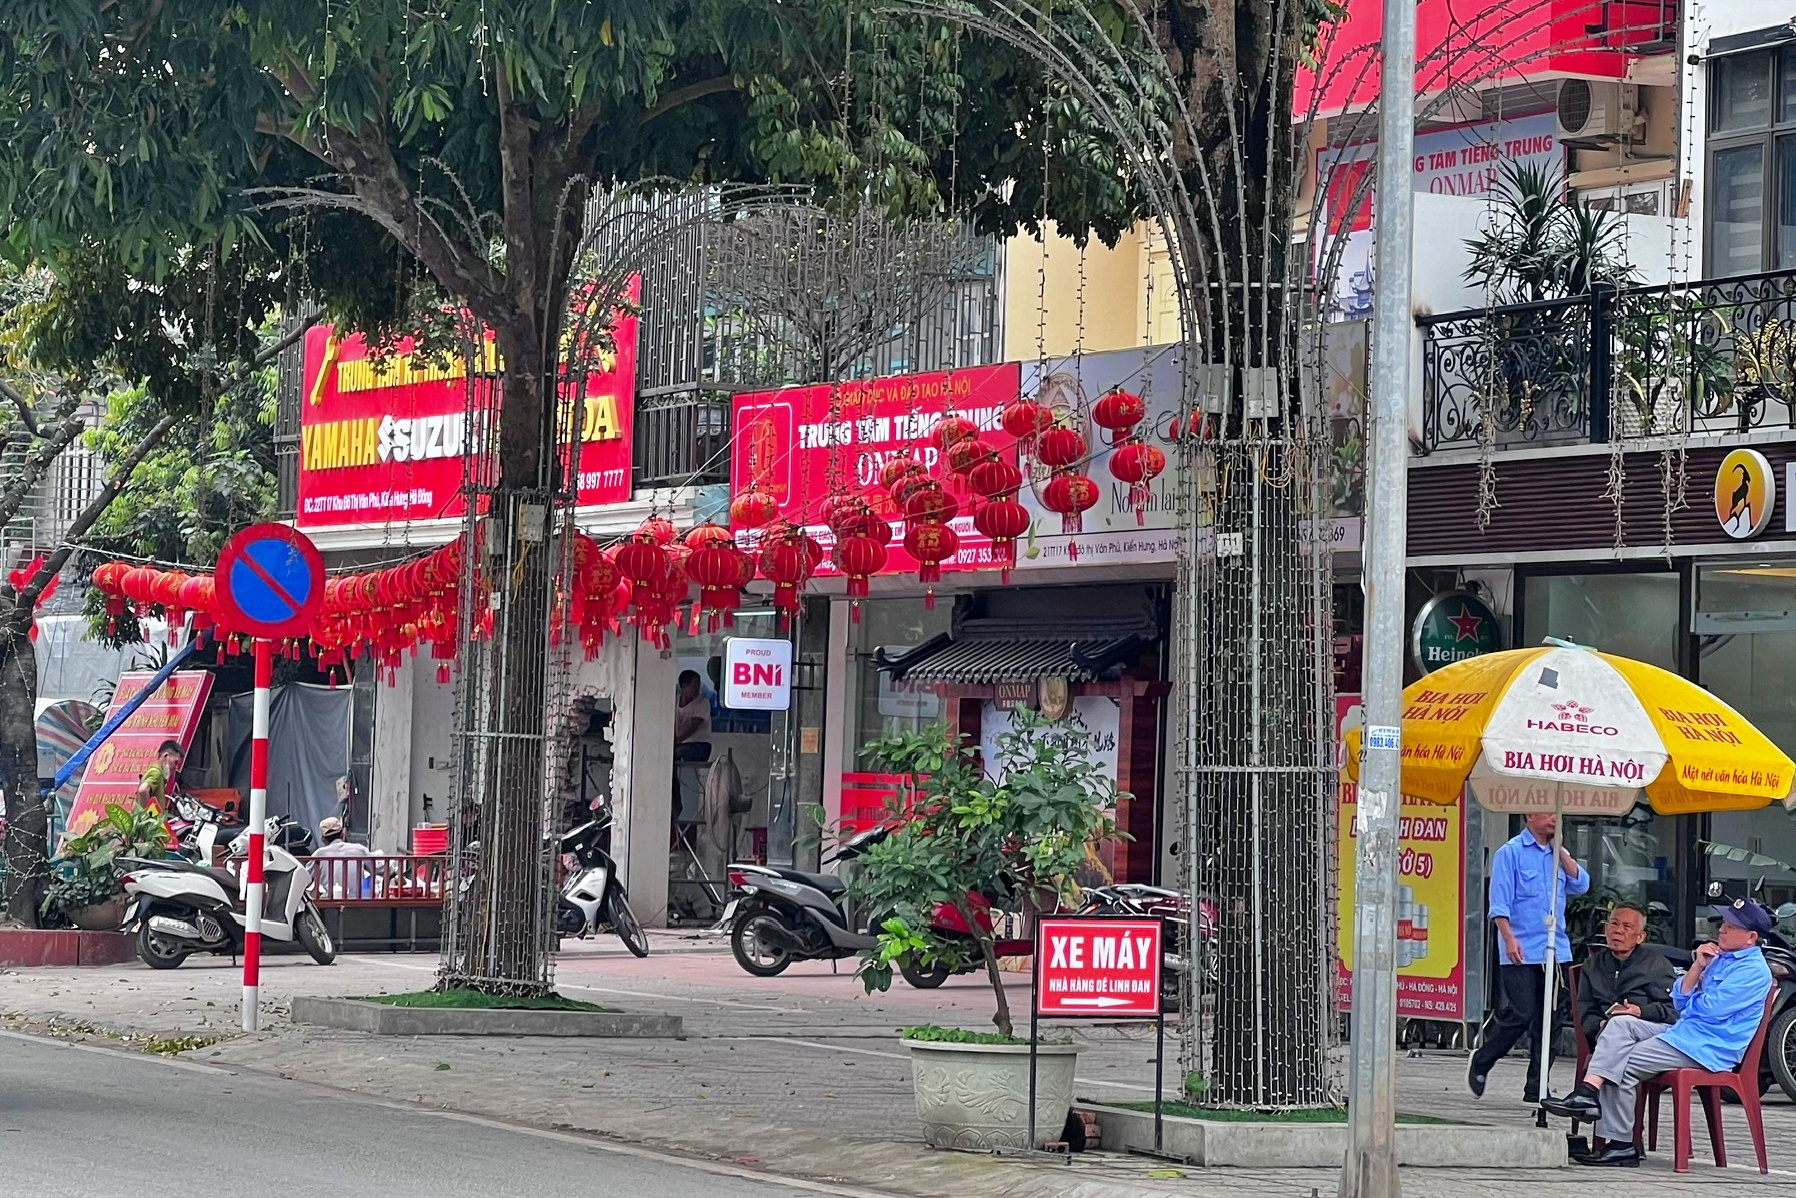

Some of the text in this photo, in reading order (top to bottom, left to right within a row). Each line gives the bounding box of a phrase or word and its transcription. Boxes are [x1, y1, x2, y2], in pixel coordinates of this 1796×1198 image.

[1428, 149, 1456, 170] TÂM
[1505, 134, 1552, 158] TRUNG
[887, 382, 898, 402] VÀ
[922, 382, 938, 402] TẠO
[955, 376, 971, 398] NỘI
[301, 416, 378, 471] YAMAHA
[604, 469, 624, 488] 7777
[957, 548, 976, 564] 0927
[746, 648, 772, 657] PROUD
[741, 692, 772, 700] MEMBER
[998, 684, 1032, 699] ONMAP
[1414, 690, 1450, 703] BIA
[1402, 704, 1470, 724] HÀ NỘI
[1658, 706, 1693, 724] BIA
[1527, 720, 1618, 736] HABECO
[1704, 728, 1744, 748] NỘI
[1414, 744, 1430, 758] hóa
[1432, 744, 1445, 759] Hà
[1446, 746, 1465, 763] Nội
[1504, 750, 1644, 783] BIA HƠI HÀ NỘI
[1682, 764, 1780, 790] Một nét văn hóa Hà Nội
[1414, 820, 1446, 838] ĐAN
[1417, 856, 1433, 876] 5)
[1050, 930, 1152, 969] XE MÁY
[1050, 976, 1068, 992] NHÀ
[1070, 976, 1094, 992] HÀNG
[1110, 980, 1130, 993] LINH
